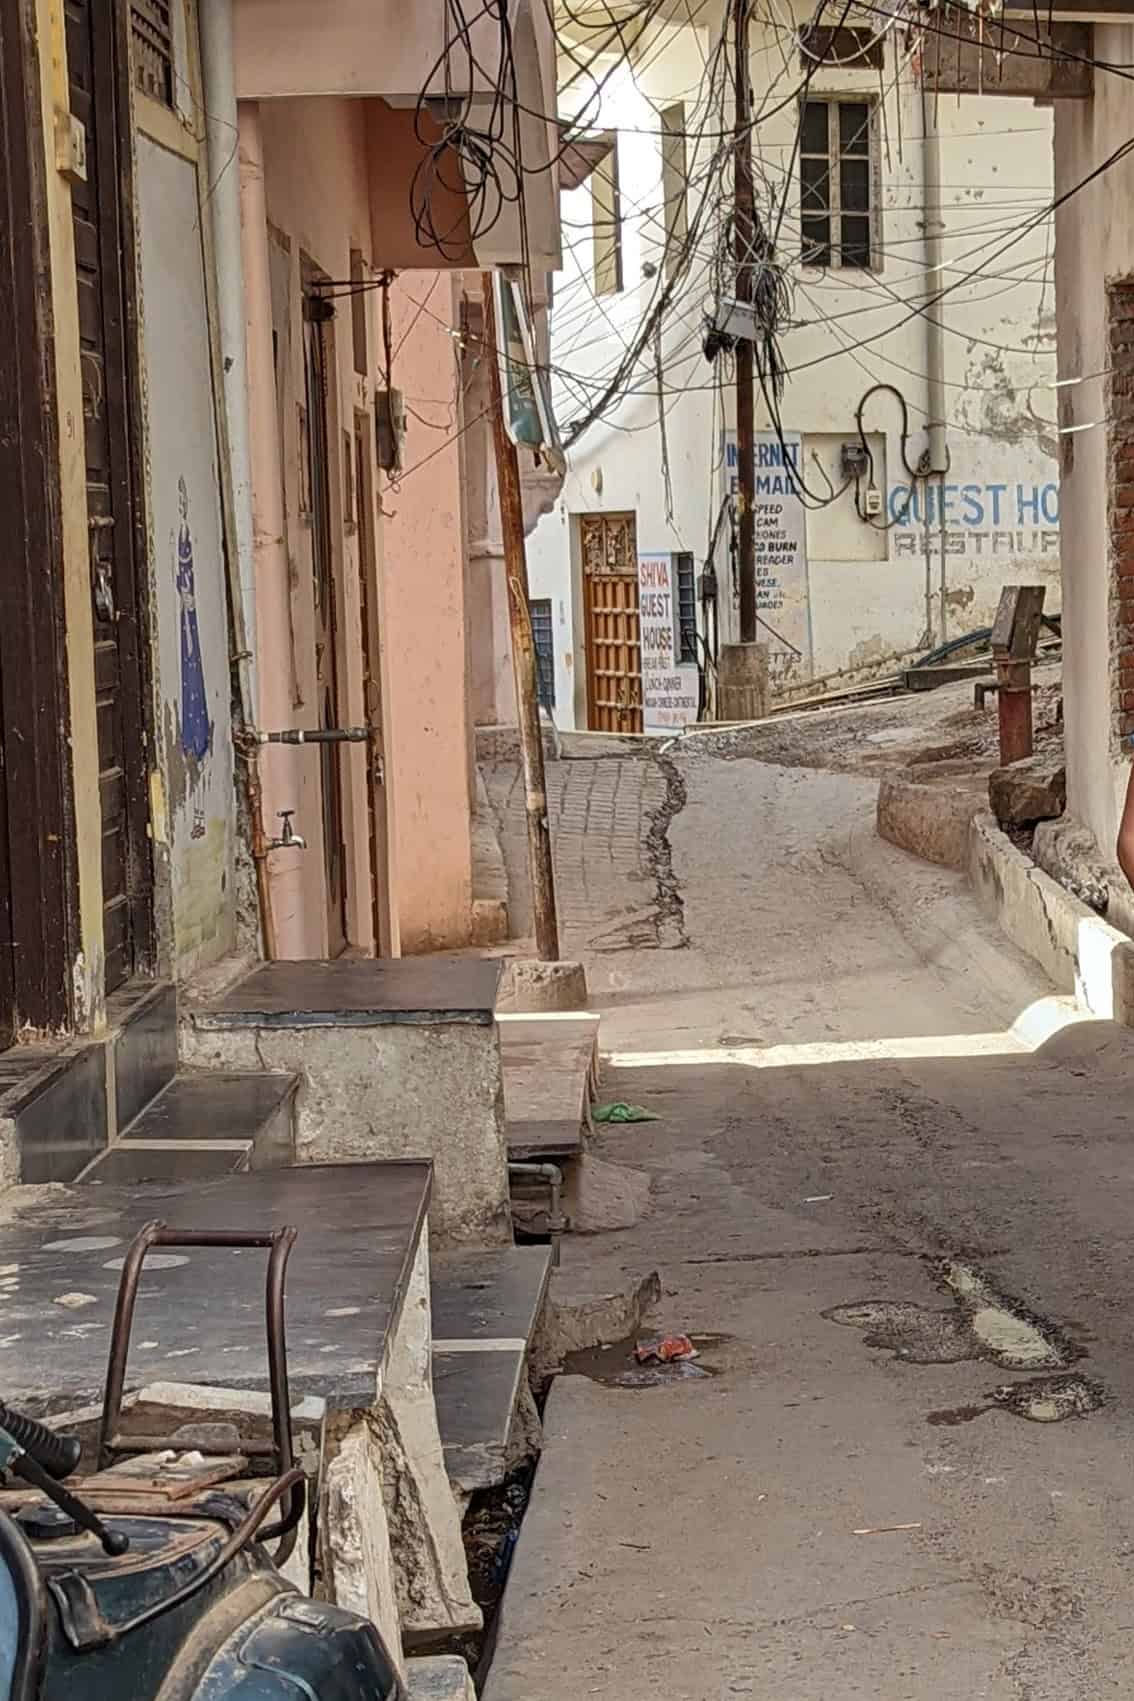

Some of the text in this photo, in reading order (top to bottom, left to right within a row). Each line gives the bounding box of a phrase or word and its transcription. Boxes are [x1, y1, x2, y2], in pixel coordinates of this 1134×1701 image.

[889, 484, 1060, 527] GUEST HO
[640, 562, 669, 587] SHIVA
[641, 593, 670, 617] GUEST
[643, 626, 672, 650] HOUSE
